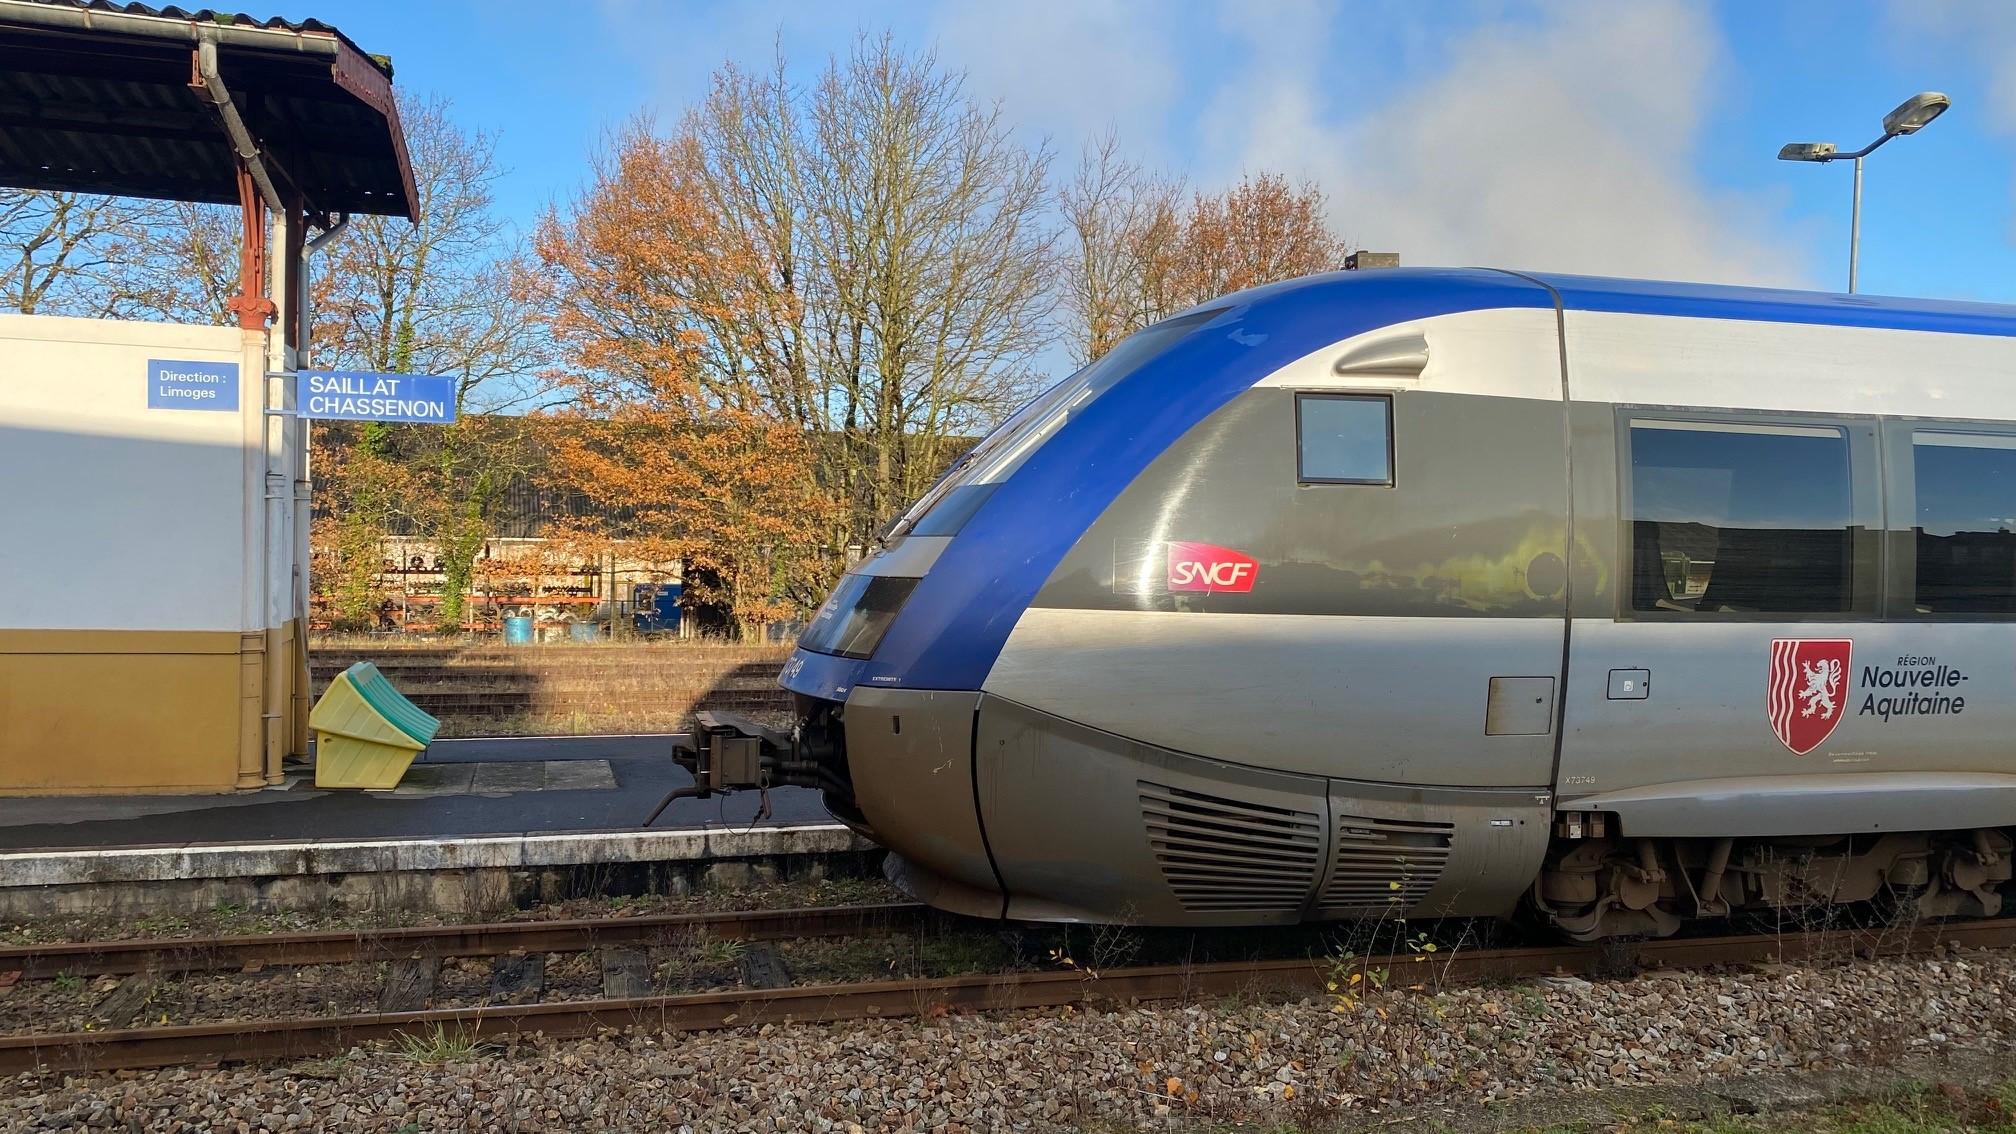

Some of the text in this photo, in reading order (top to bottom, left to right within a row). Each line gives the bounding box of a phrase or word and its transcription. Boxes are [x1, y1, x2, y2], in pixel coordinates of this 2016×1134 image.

[160, 370, 219, 383] Direction
[310, 376, 401, 396] SAILLAT
[160, 385, 216, 400] Limoges
[309, 396, 444, 418] CHASSENON
[1171, 561, 1253, 586] SNCF
[1897, 654, 1936, 667] RÉGION
[1861, 665, 1969, 688] Nouvelle-
[1859, 691, 1965, 723] Aquitaine
[1564, 776, 1596, 785] X73749
